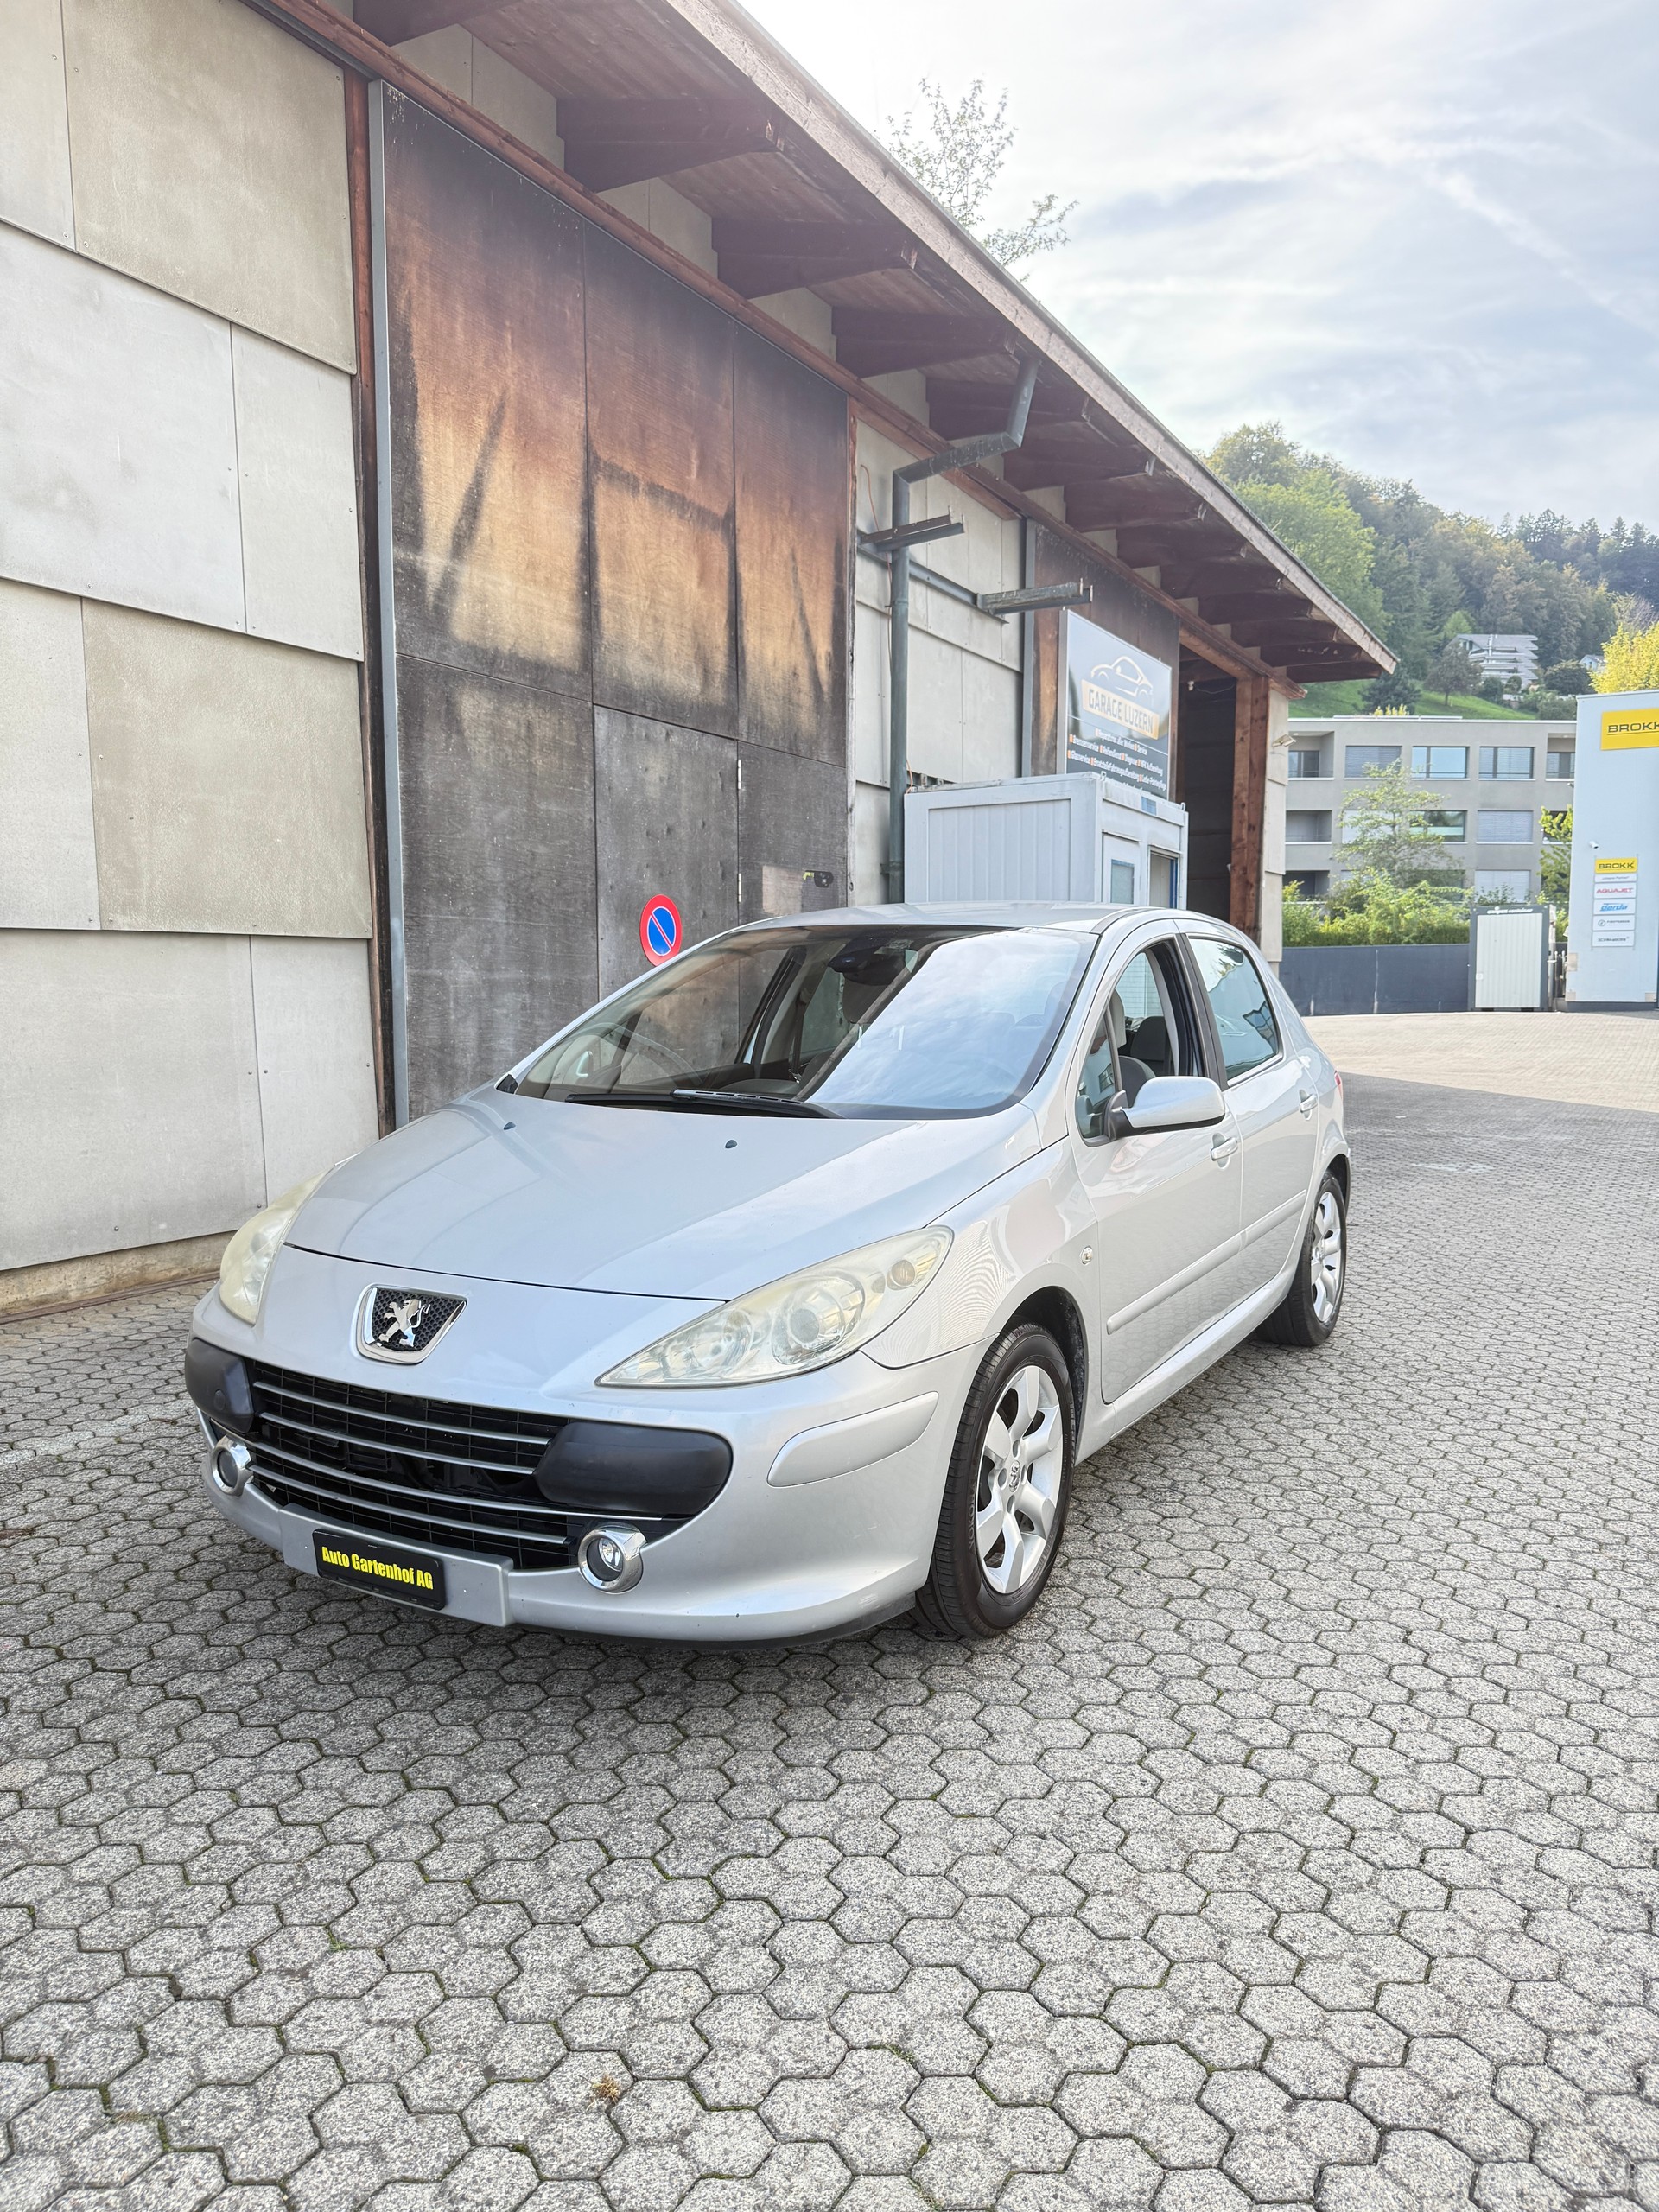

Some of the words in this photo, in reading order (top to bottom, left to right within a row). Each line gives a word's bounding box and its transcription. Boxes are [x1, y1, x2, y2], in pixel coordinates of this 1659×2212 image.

[1089, 689, 1122, 721] GARAGE
[1125, 704, 1153, 734] LUZERN
[1599, 903, 1628, 912] darda
[321, 1546, 350, 1568] Auto
[351, 1553, 414, 1585] Gartenhof
[416, 1569, 434, 1590] AG
